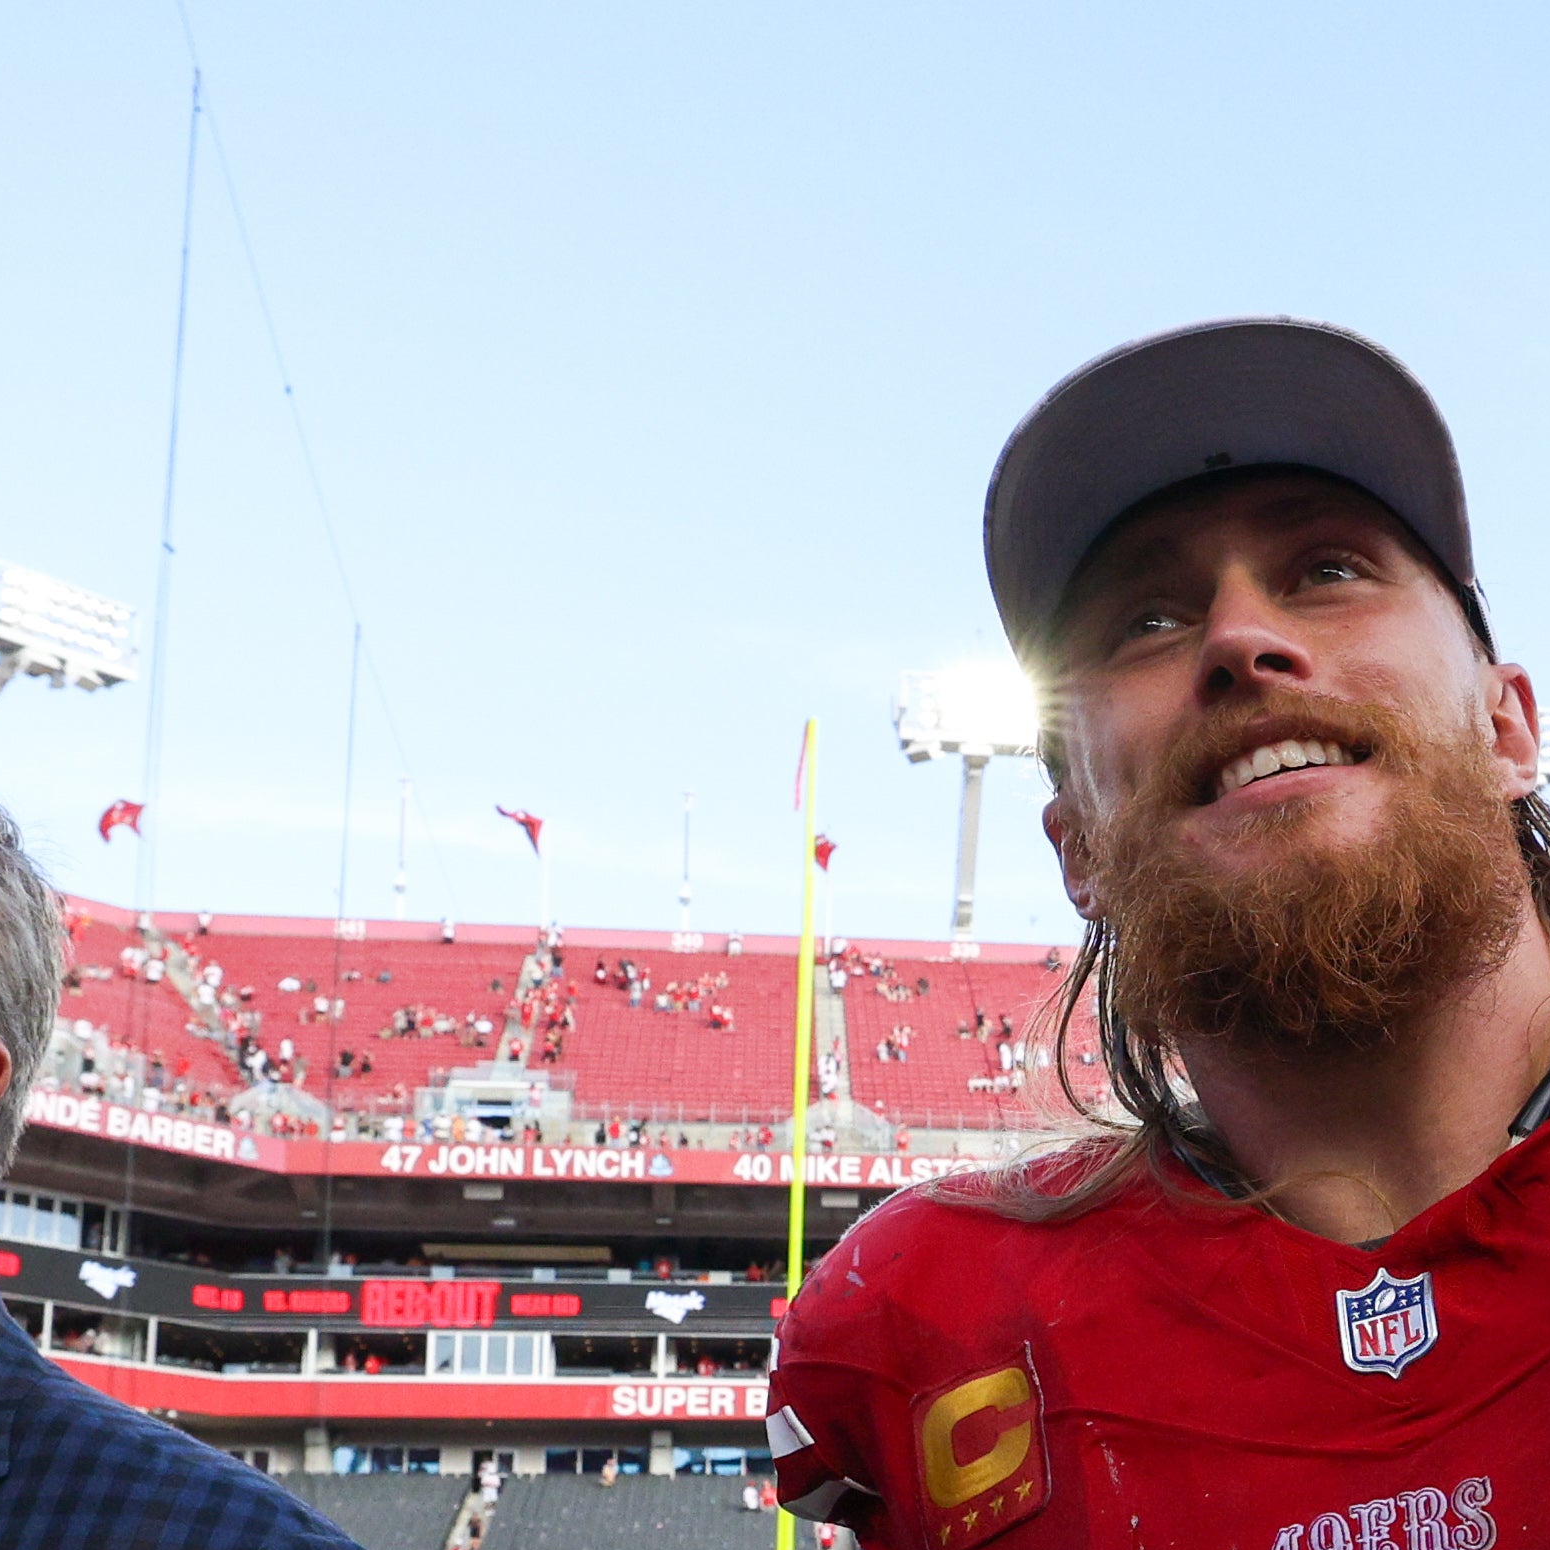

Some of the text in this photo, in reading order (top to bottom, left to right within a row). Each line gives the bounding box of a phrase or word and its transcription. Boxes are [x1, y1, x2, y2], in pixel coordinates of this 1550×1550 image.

[25, 1090, 236, 1160] NDÉ BARBER
[380, 1144, 646, 1178] 47 JOHN LYNCH
[733, 1154, 772, 1182] 40
[429, 1279, 502, 1328] OUT
[1355, 1309, 1423, 1357] NFL
[612, 1385, 736, 1417] SUPER
[921, 1366, 1033, 1509] C
